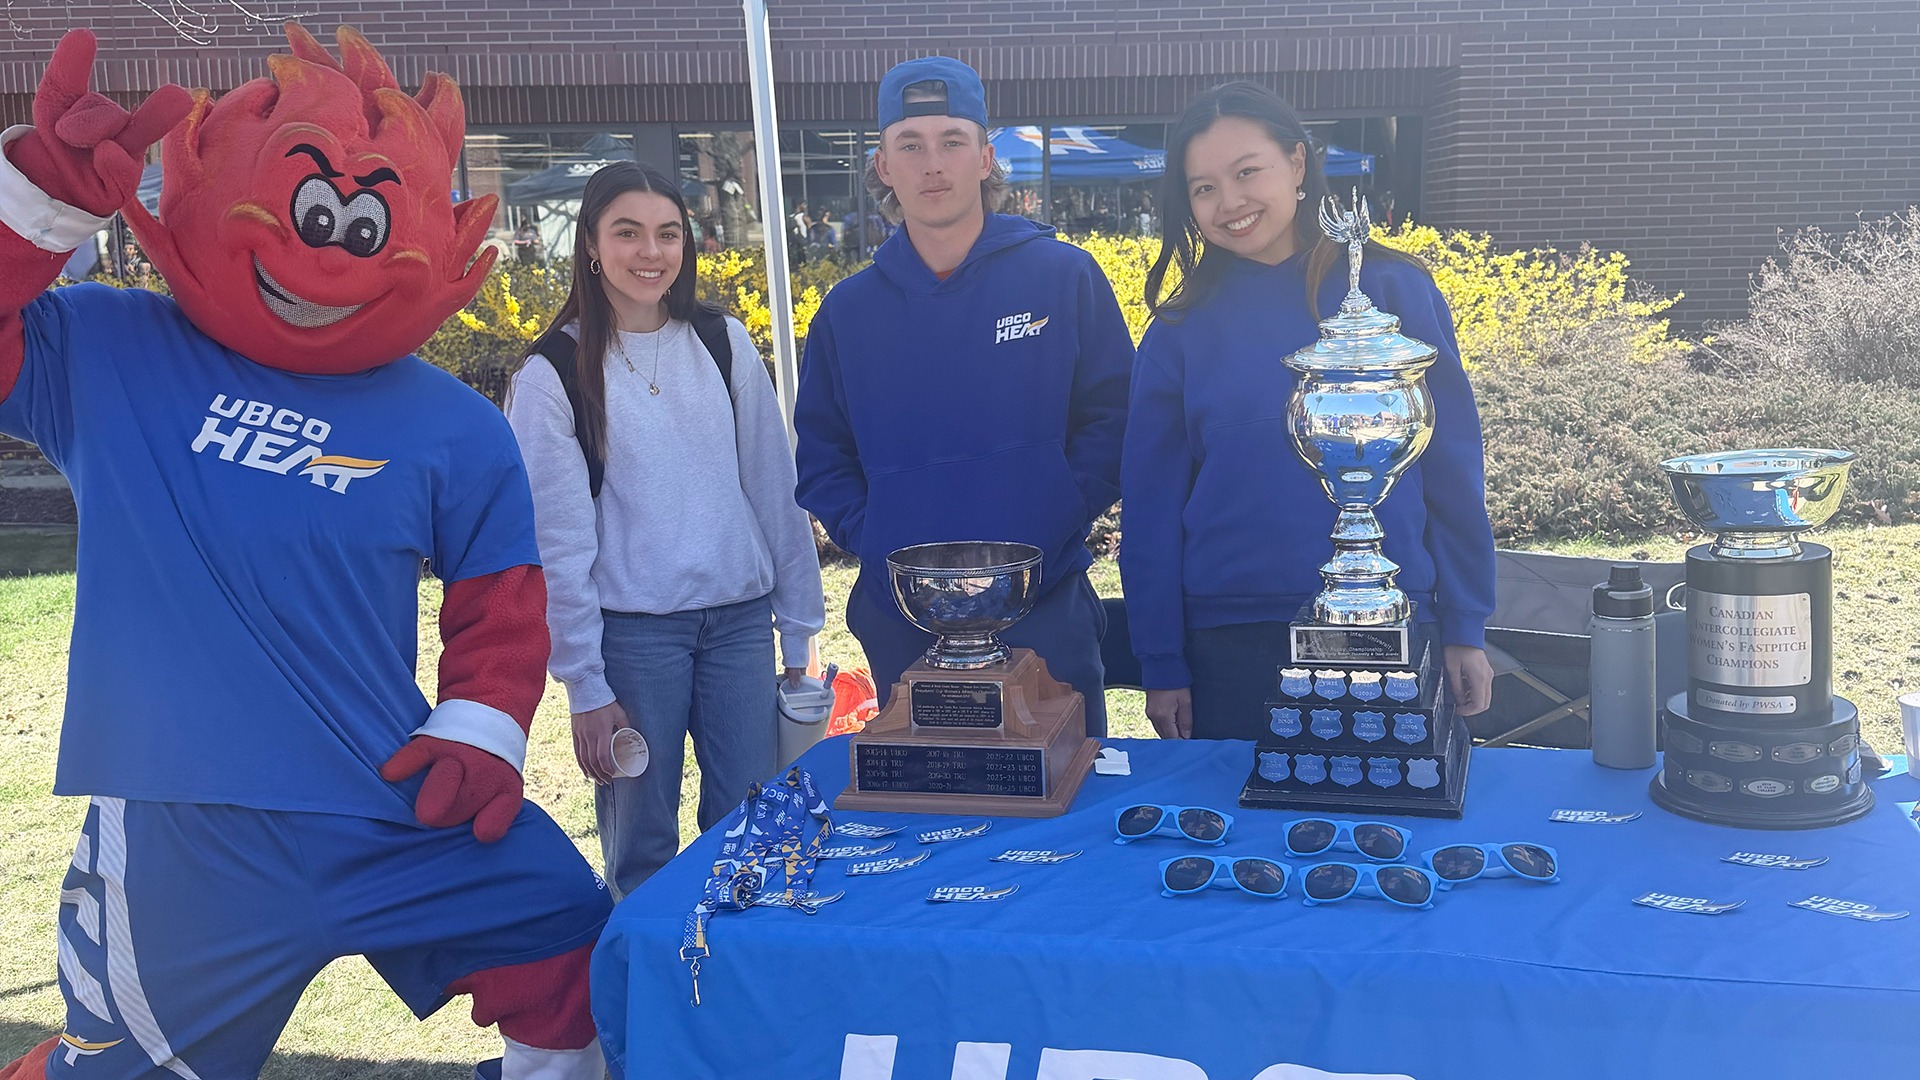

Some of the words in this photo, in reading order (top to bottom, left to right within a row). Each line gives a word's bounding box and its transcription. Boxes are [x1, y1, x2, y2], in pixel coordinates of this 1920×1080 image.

[995, 312, 1031, 329] UBCO
[995, 315, 1050, 344] HEAT
[209, 393, 332, 444] UBCO
[190, 416, 391, 495] HEAT
[1739, 700, 1750, 710] by
[1752, 701, 1783, 709] PWSA
[920, 827, 963, 838] UBCO
[852, 850, 926, 874] HEAT
[853, 857, 899, 868] UBCO
[1735, 851, 1791, 860] UBCO
[933, 888, 1011, 900] HEAT
[1650, 892, 1709, 905] UBCO
[1641, 896, 1738, 912] HEAT
[1797, 899, 1900, 919] HEAT
[1809, 895, 1870, 911] UBCO
